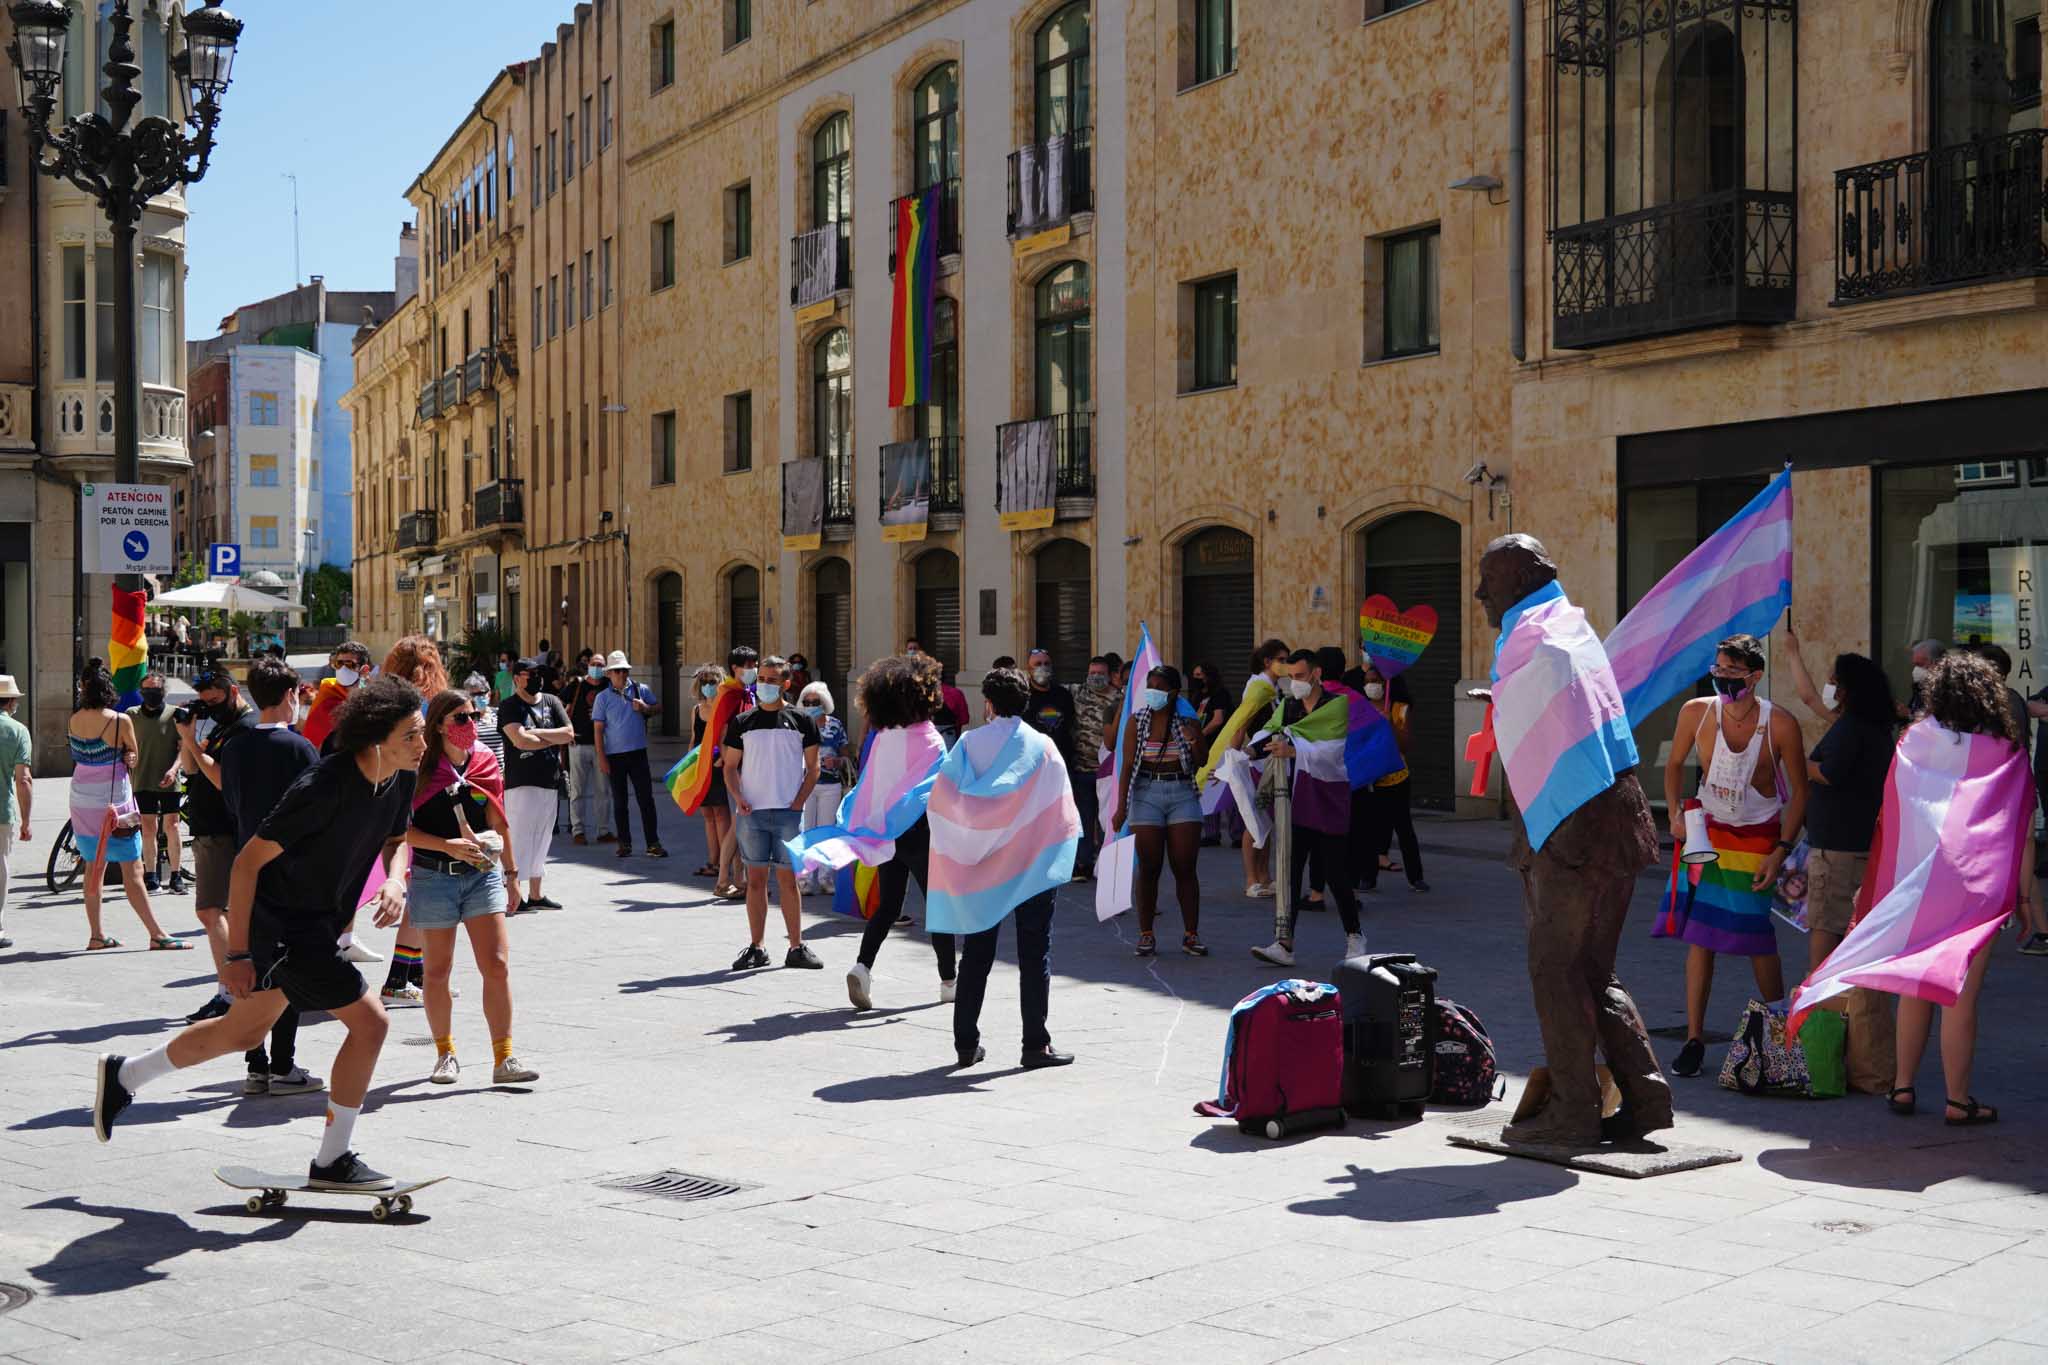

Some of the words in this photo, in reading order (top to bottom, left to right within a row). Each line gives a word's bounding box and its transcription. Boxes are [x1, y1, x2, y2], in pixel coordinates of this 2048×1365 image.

[107, 491, 162, 502] ATENCIÓN
[102, 506, 133, 515] PEATÓN
[137, 507, 168, 516] CAMINE
[100, 517, 117, 525] POR
[120, 518, 130, 526] LA
[216, 546, 237, 573] P
